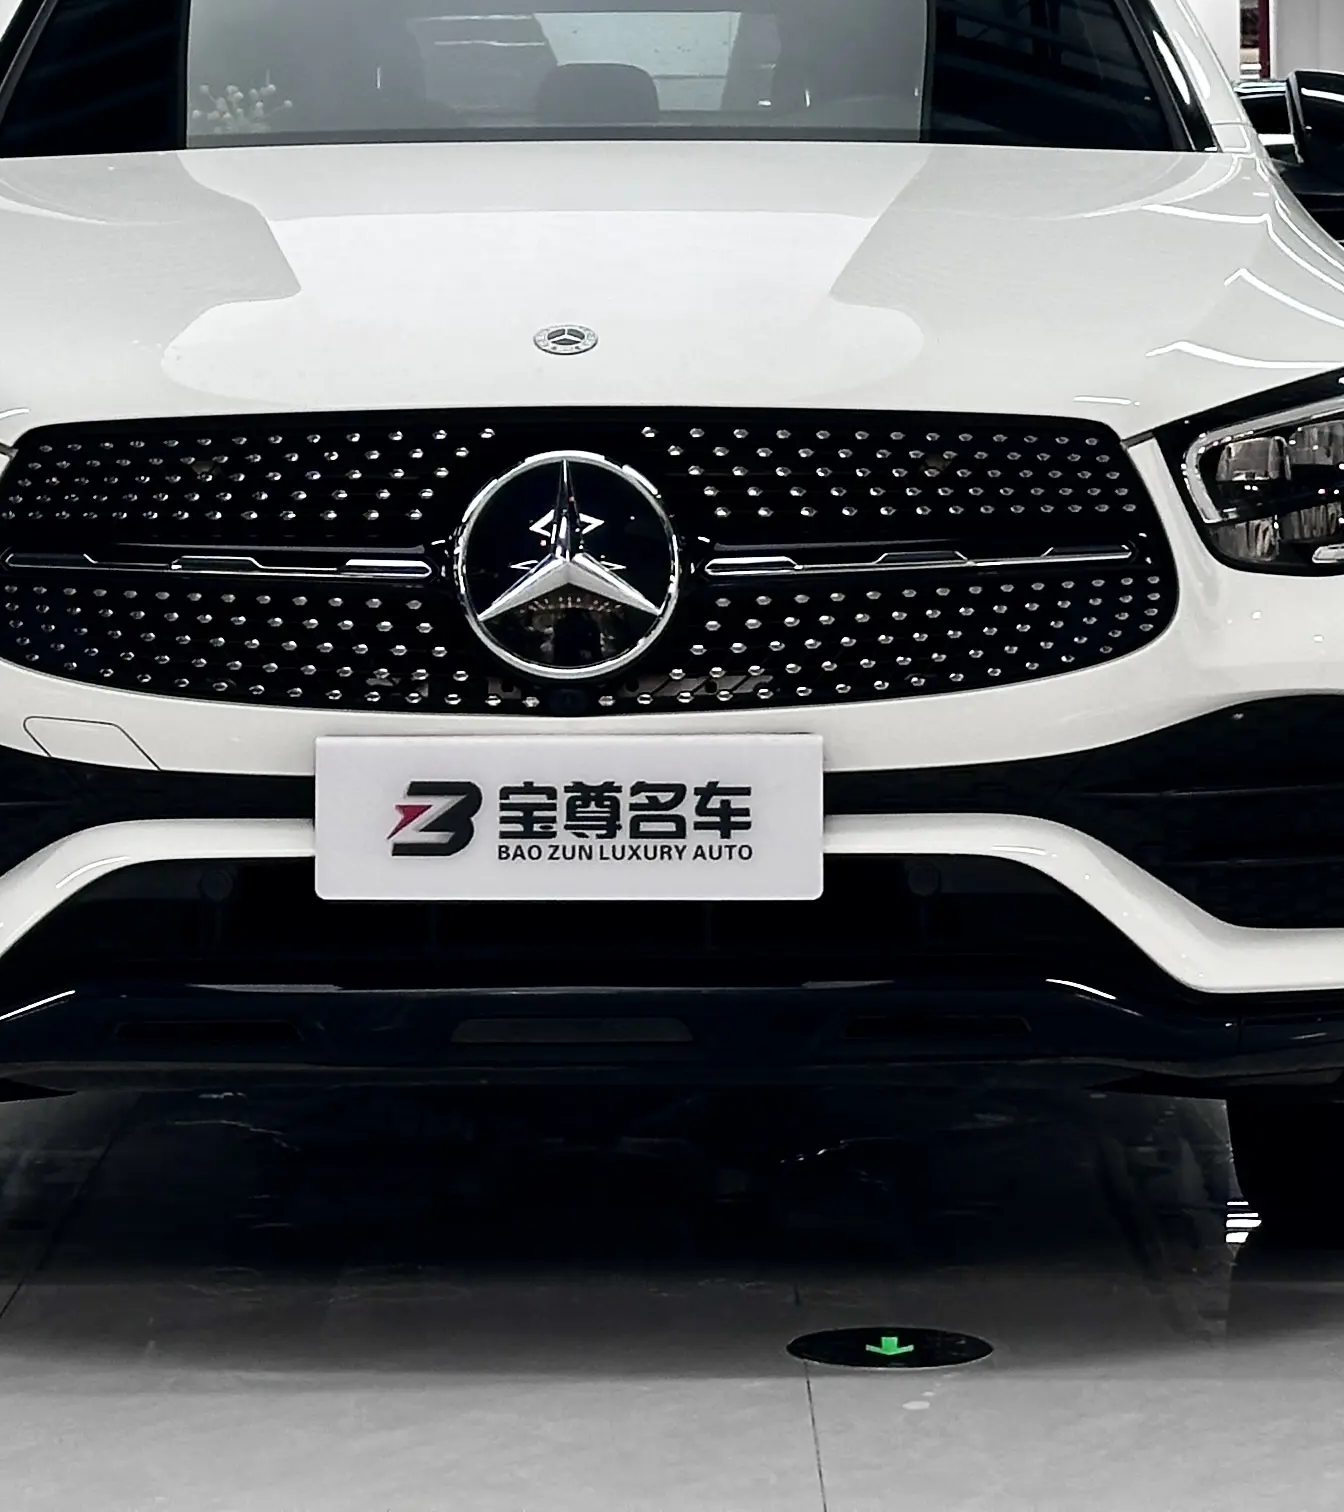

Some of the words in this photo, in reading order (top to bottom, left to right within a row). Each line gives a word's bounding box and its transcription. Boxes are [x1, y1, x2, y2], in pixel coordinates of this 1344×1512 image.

[498, 780, 753, 840] 宝尊名车
[497, 844, 543, 861] BAO
[547, 844, 593, 861] ZUN
[599, 844, 687, 861] LUXURY
[692, 844, 754, 861] AUTO
